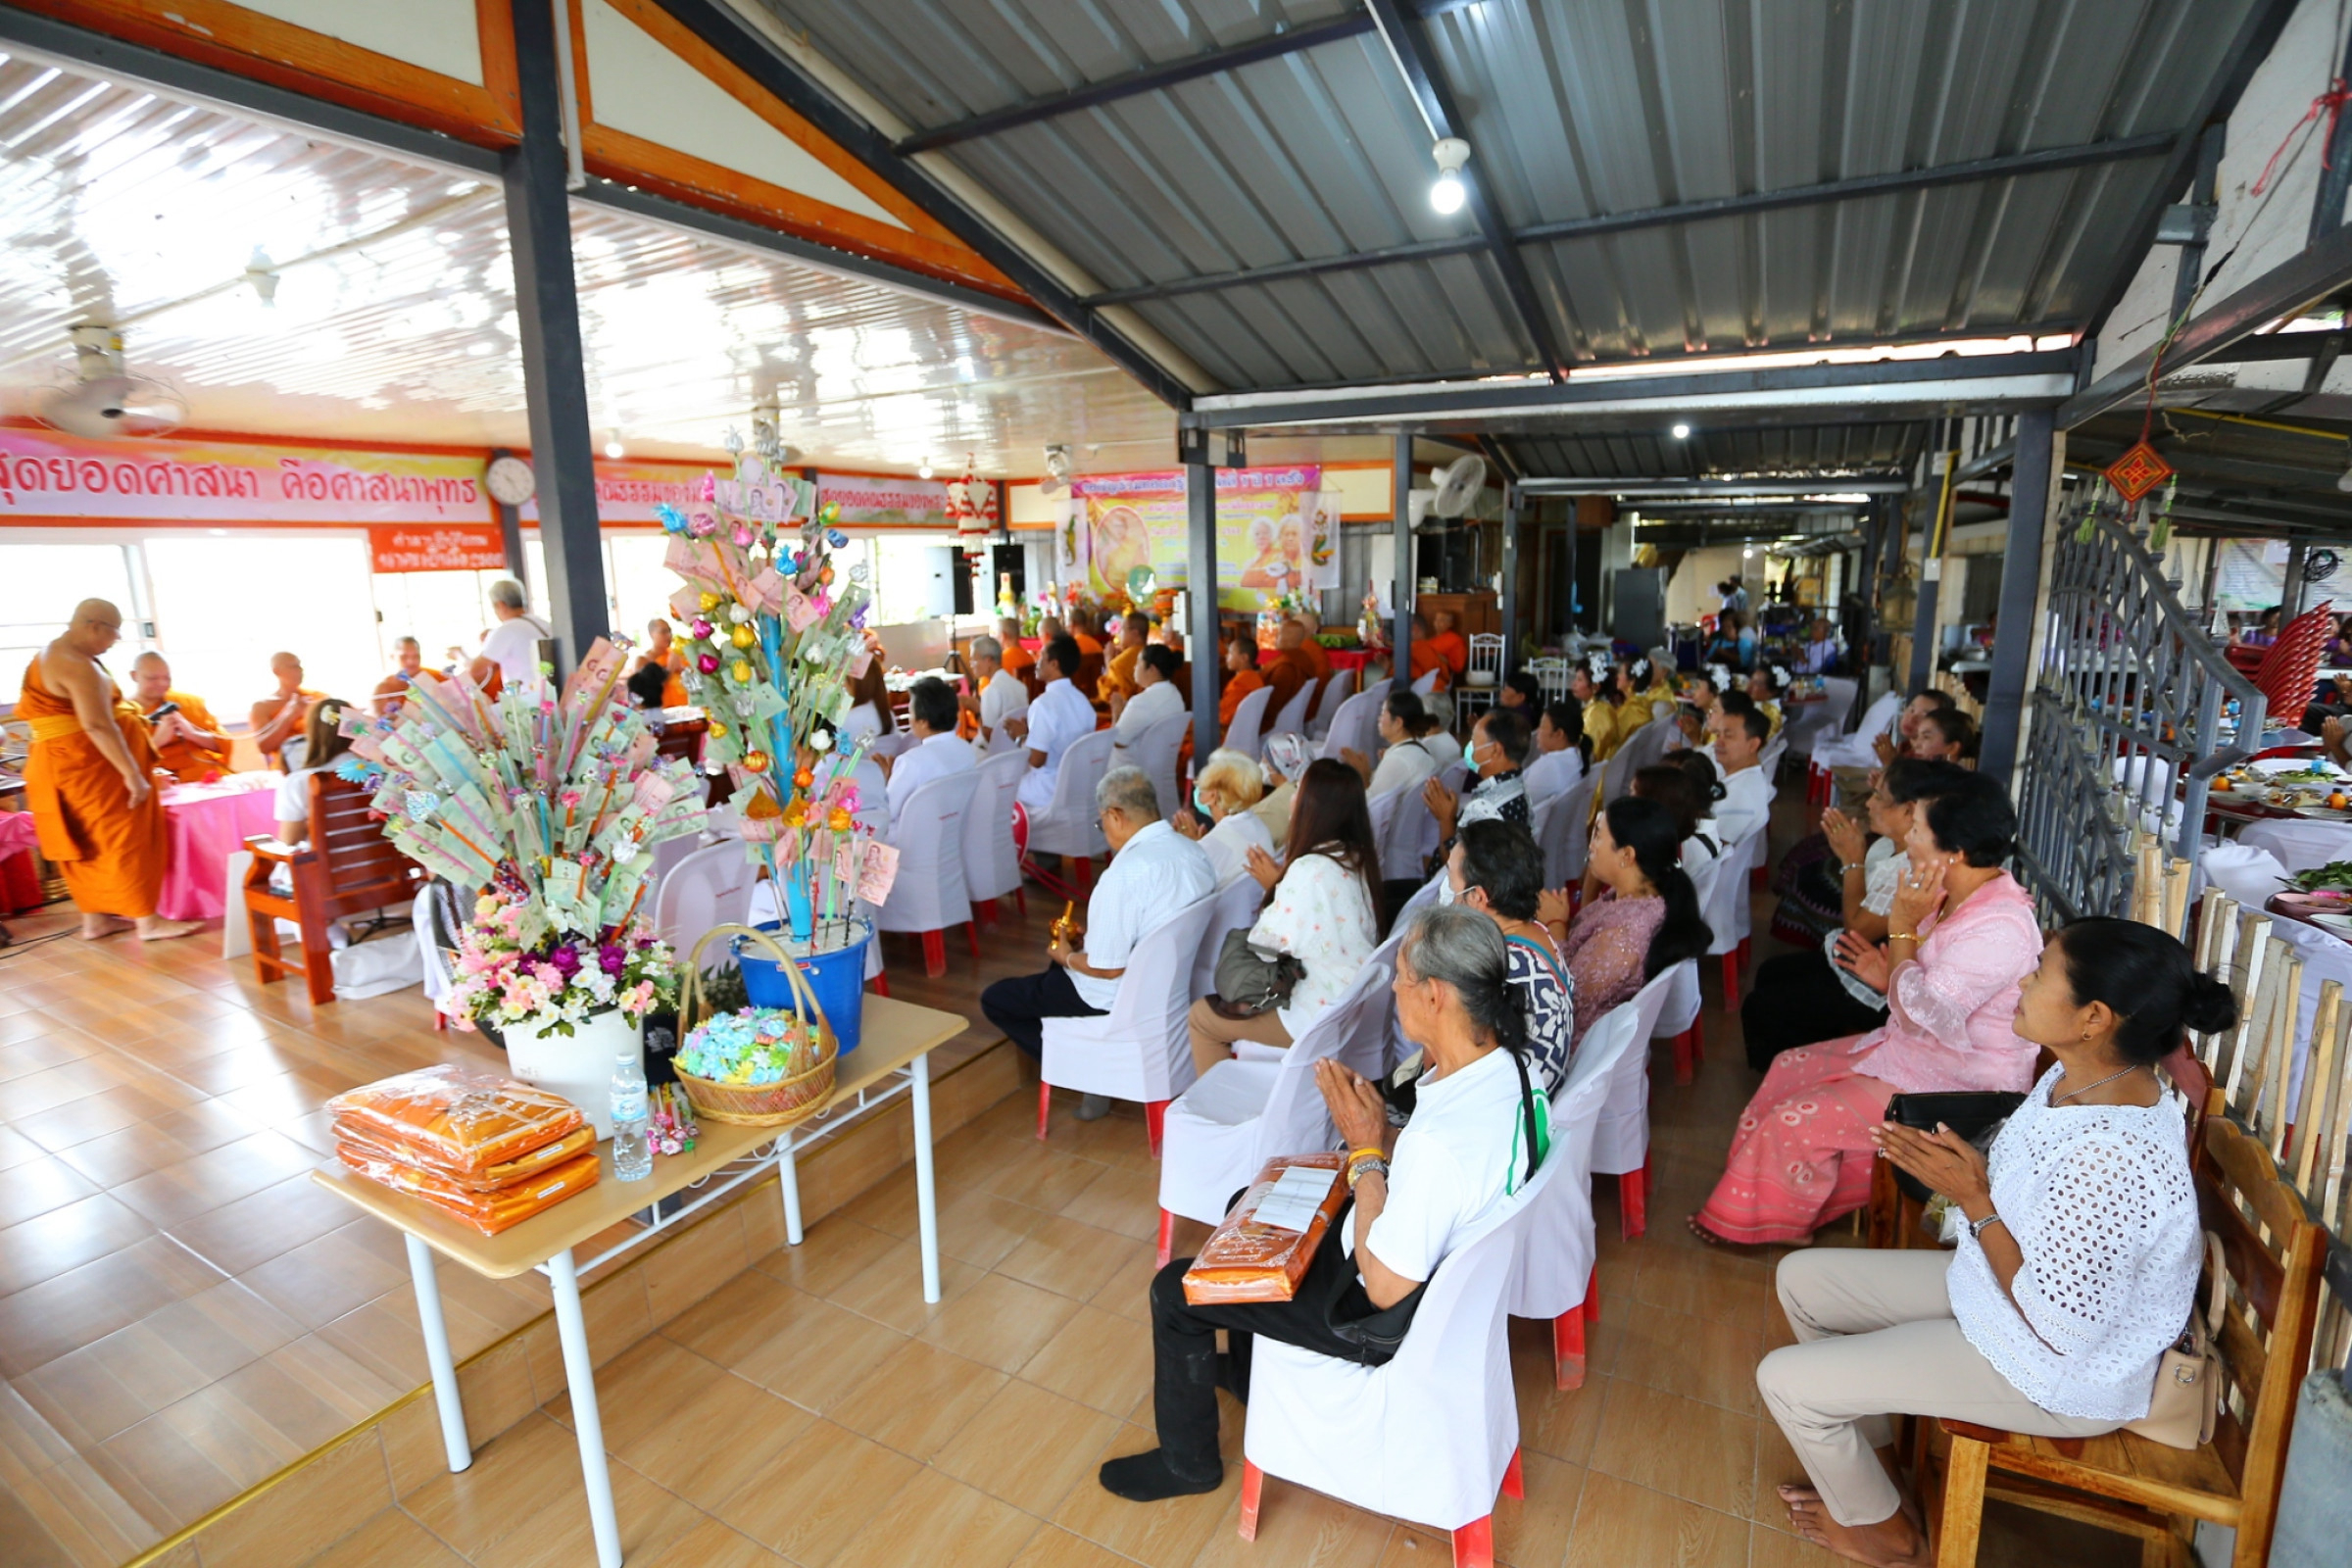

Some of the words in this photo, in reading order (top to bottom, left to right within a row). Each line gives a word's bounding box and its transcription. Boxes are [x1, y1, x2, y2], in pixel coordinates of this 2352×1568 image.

[279, 458, 477, 514] คือศาสนาพุทธ
